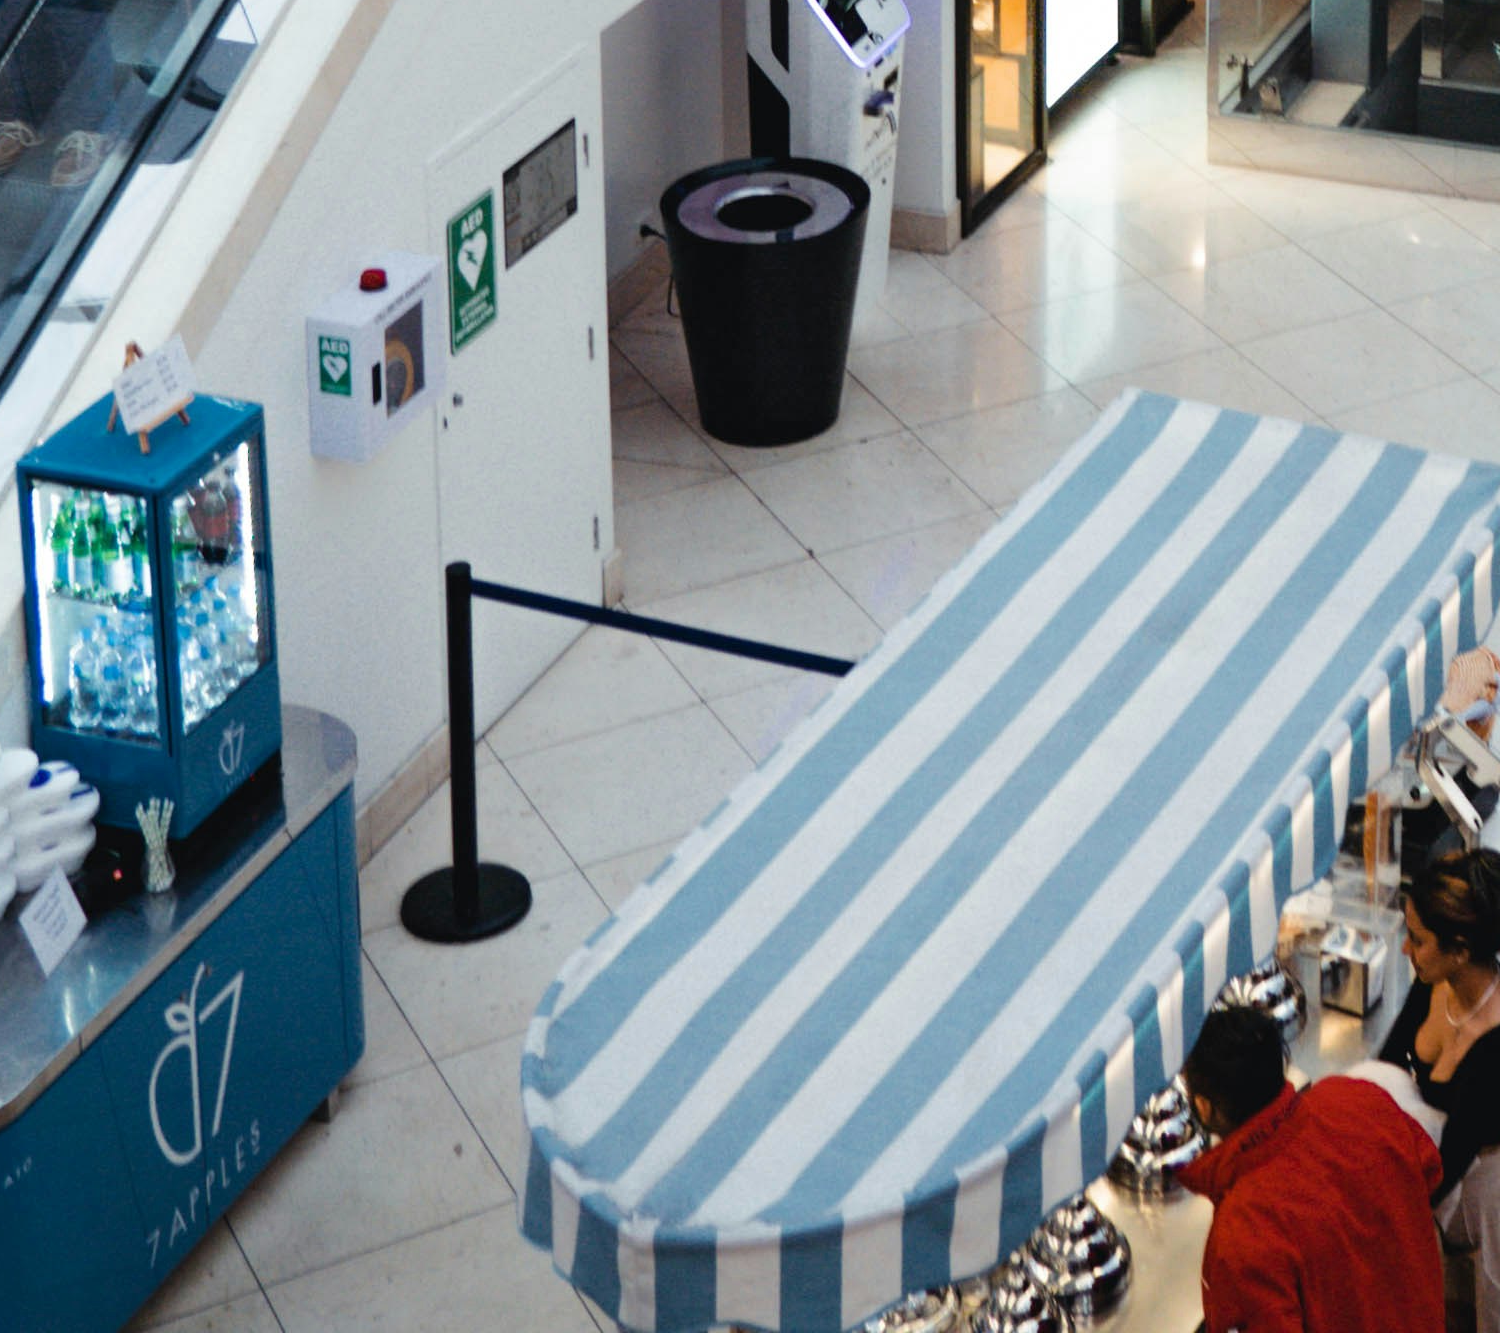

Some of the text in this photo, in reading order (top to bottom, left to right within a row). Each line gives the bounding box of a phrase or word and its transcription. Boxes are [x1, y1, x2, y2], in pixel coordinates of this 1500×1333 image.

[460, 207, 484, 239] AED
[321, 339, 349, 355] AED
[168, 1118, 262, 1248] APPLES
